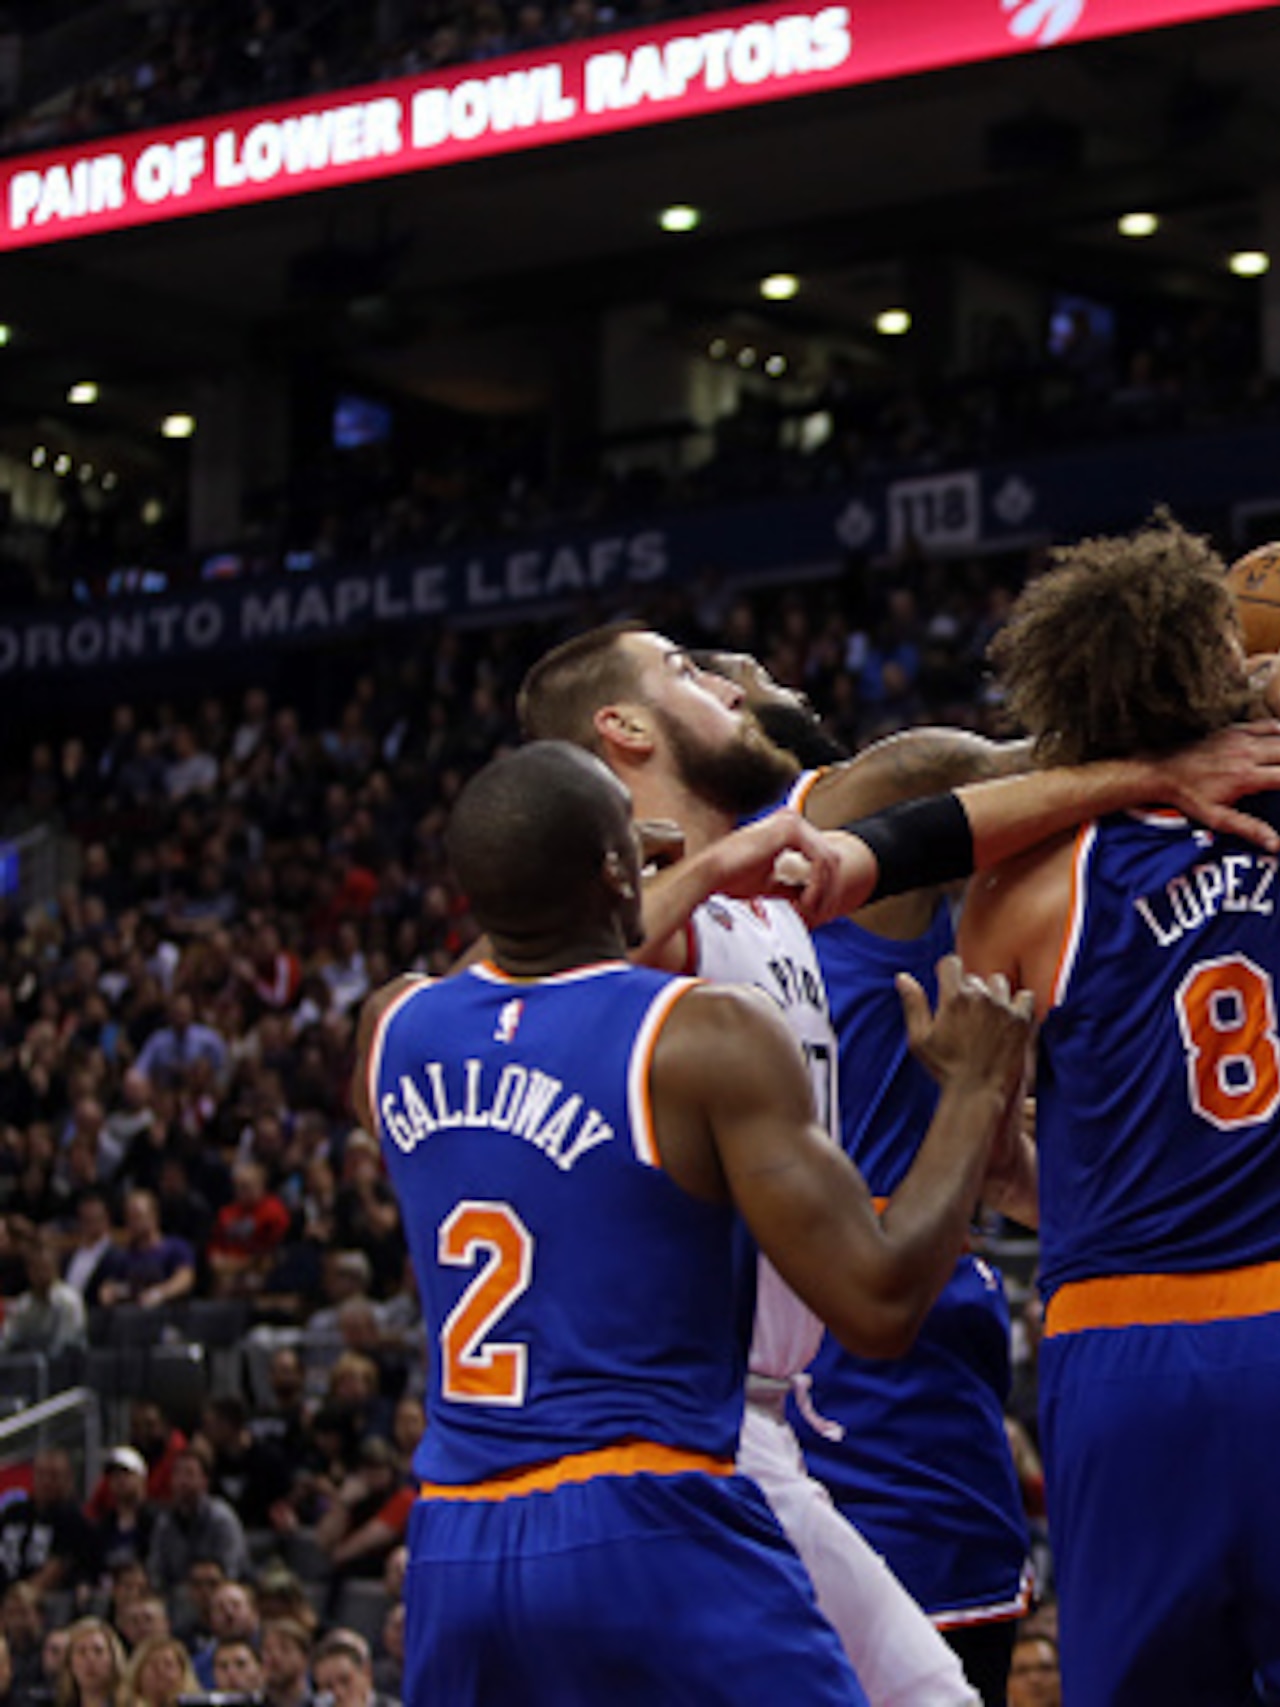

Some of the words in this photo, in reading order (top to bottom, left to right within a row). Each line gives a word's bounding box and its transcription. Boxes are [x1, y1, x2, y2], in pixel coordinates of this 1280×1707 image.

[9, 153, 126, 231] PAIR
[134, 137, 206, 203] OF
[213, 97, 403, 189] LOWER
[411, 63, 577, 149] BOWL
[583, 6, 852, 114] RAPTORS
[239, 564, 448, 641] MAPLE
[466, 529, 669, 604] LEAFS
[1134, 855, 1279, 947] LOPEZ
[381, 1058, 614, 1172] GALLOWAY
[437, 1200, 534, 1409] 2
